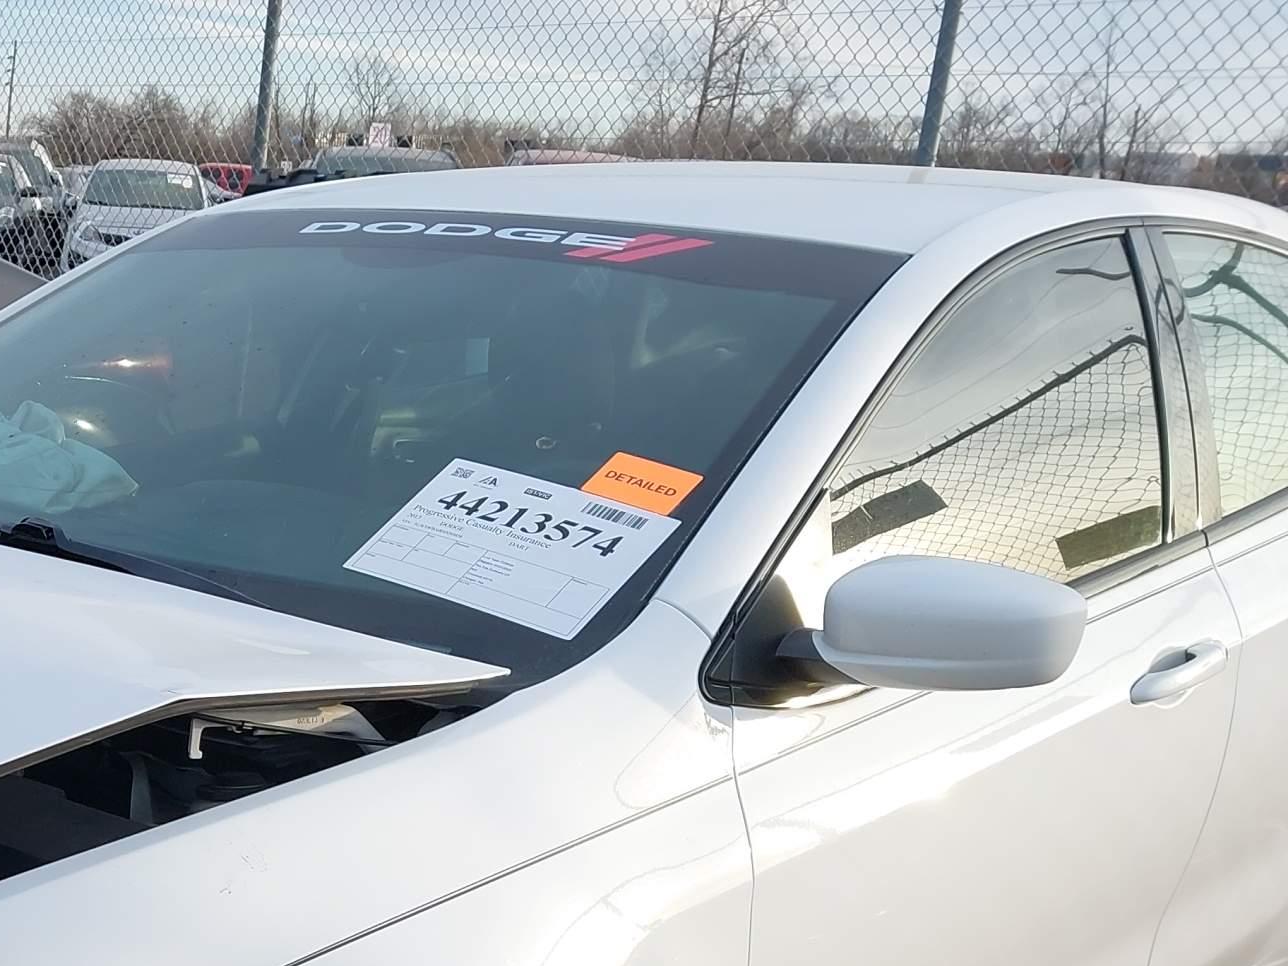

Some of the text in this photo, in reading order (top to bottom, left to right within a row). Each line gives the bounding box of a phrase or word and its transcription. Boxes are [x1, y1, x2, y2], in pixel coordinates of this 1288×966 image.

[298, 221, 637, 251] DODGE
[604, 470, 678, 497] DETAILED
[414, 504, 466, 523] Progressive
[465, 519, 504, 537] Casualty
[506, 530, 552, 549] Insurance
[437, 490, 625, 557] 44213574
